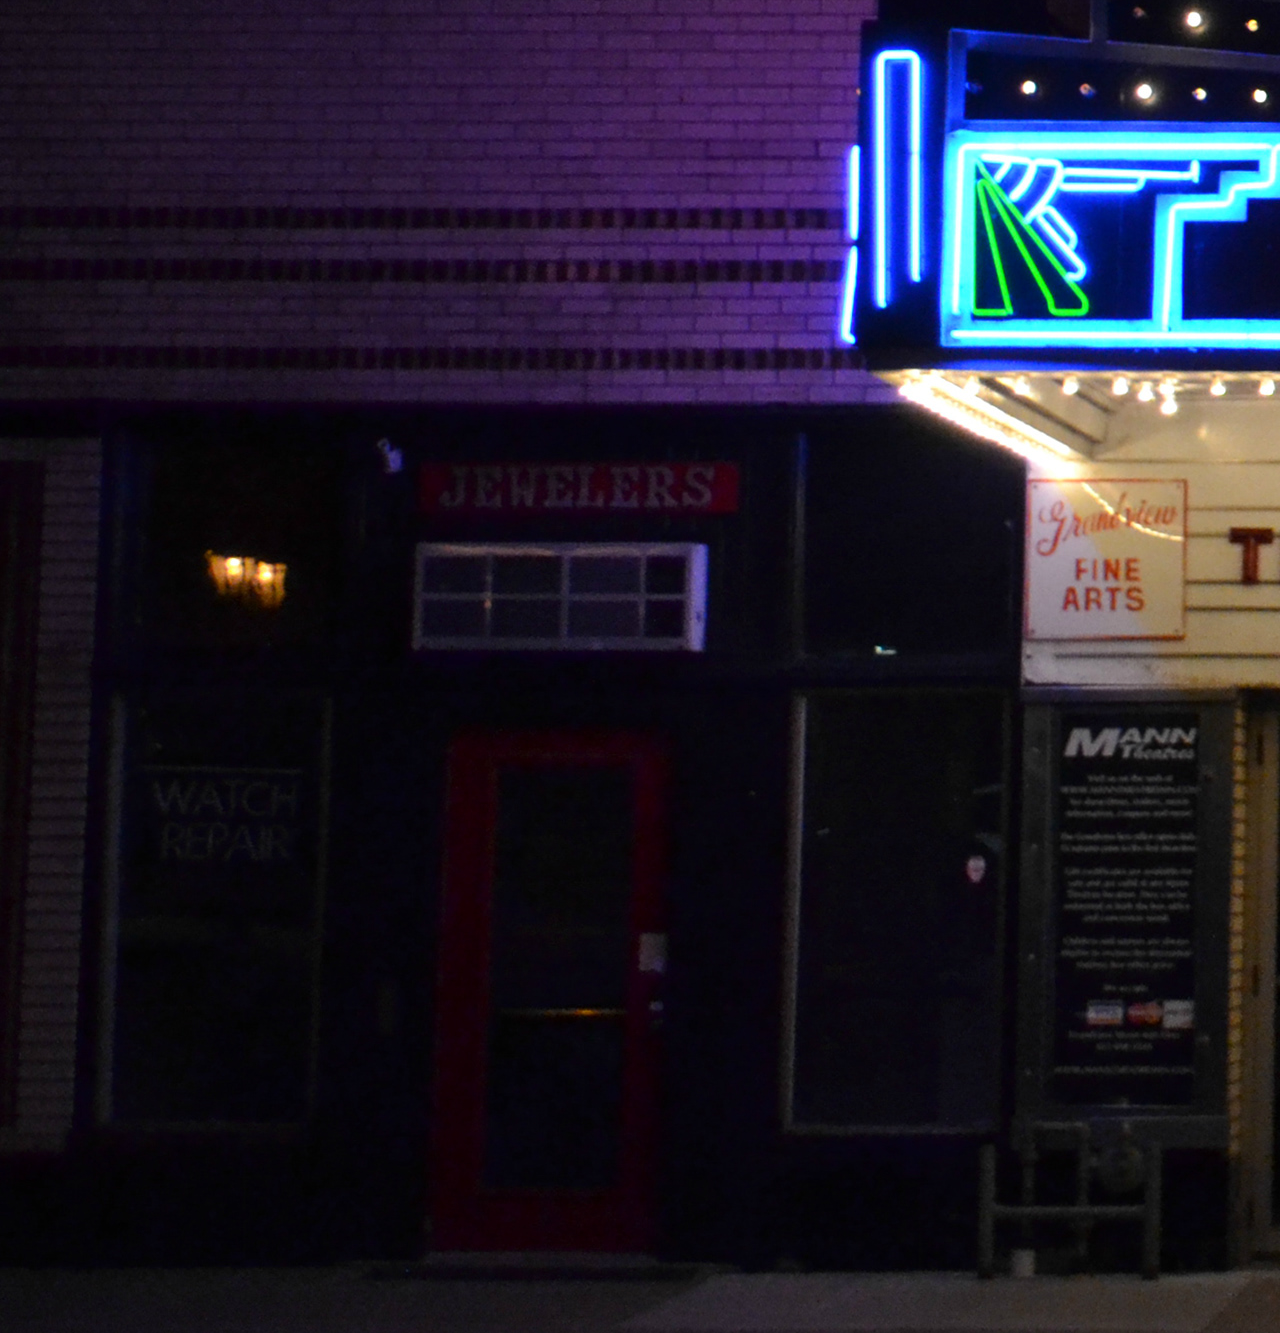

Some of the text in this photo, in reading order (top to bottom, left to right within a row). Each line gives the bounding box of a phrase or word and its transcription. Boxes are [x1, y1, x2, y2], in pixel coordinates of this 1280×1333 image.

[438, 466, 715, 509] JEWELERS
[1075, 557, 1141, 582] FINE
[1062, 586, 1146, 611] ARTS
[1063, 727, 1198, 758] MANN
[152, 779, 298, 817] WATCH
[160, 821, 291, 862] REPAIR
